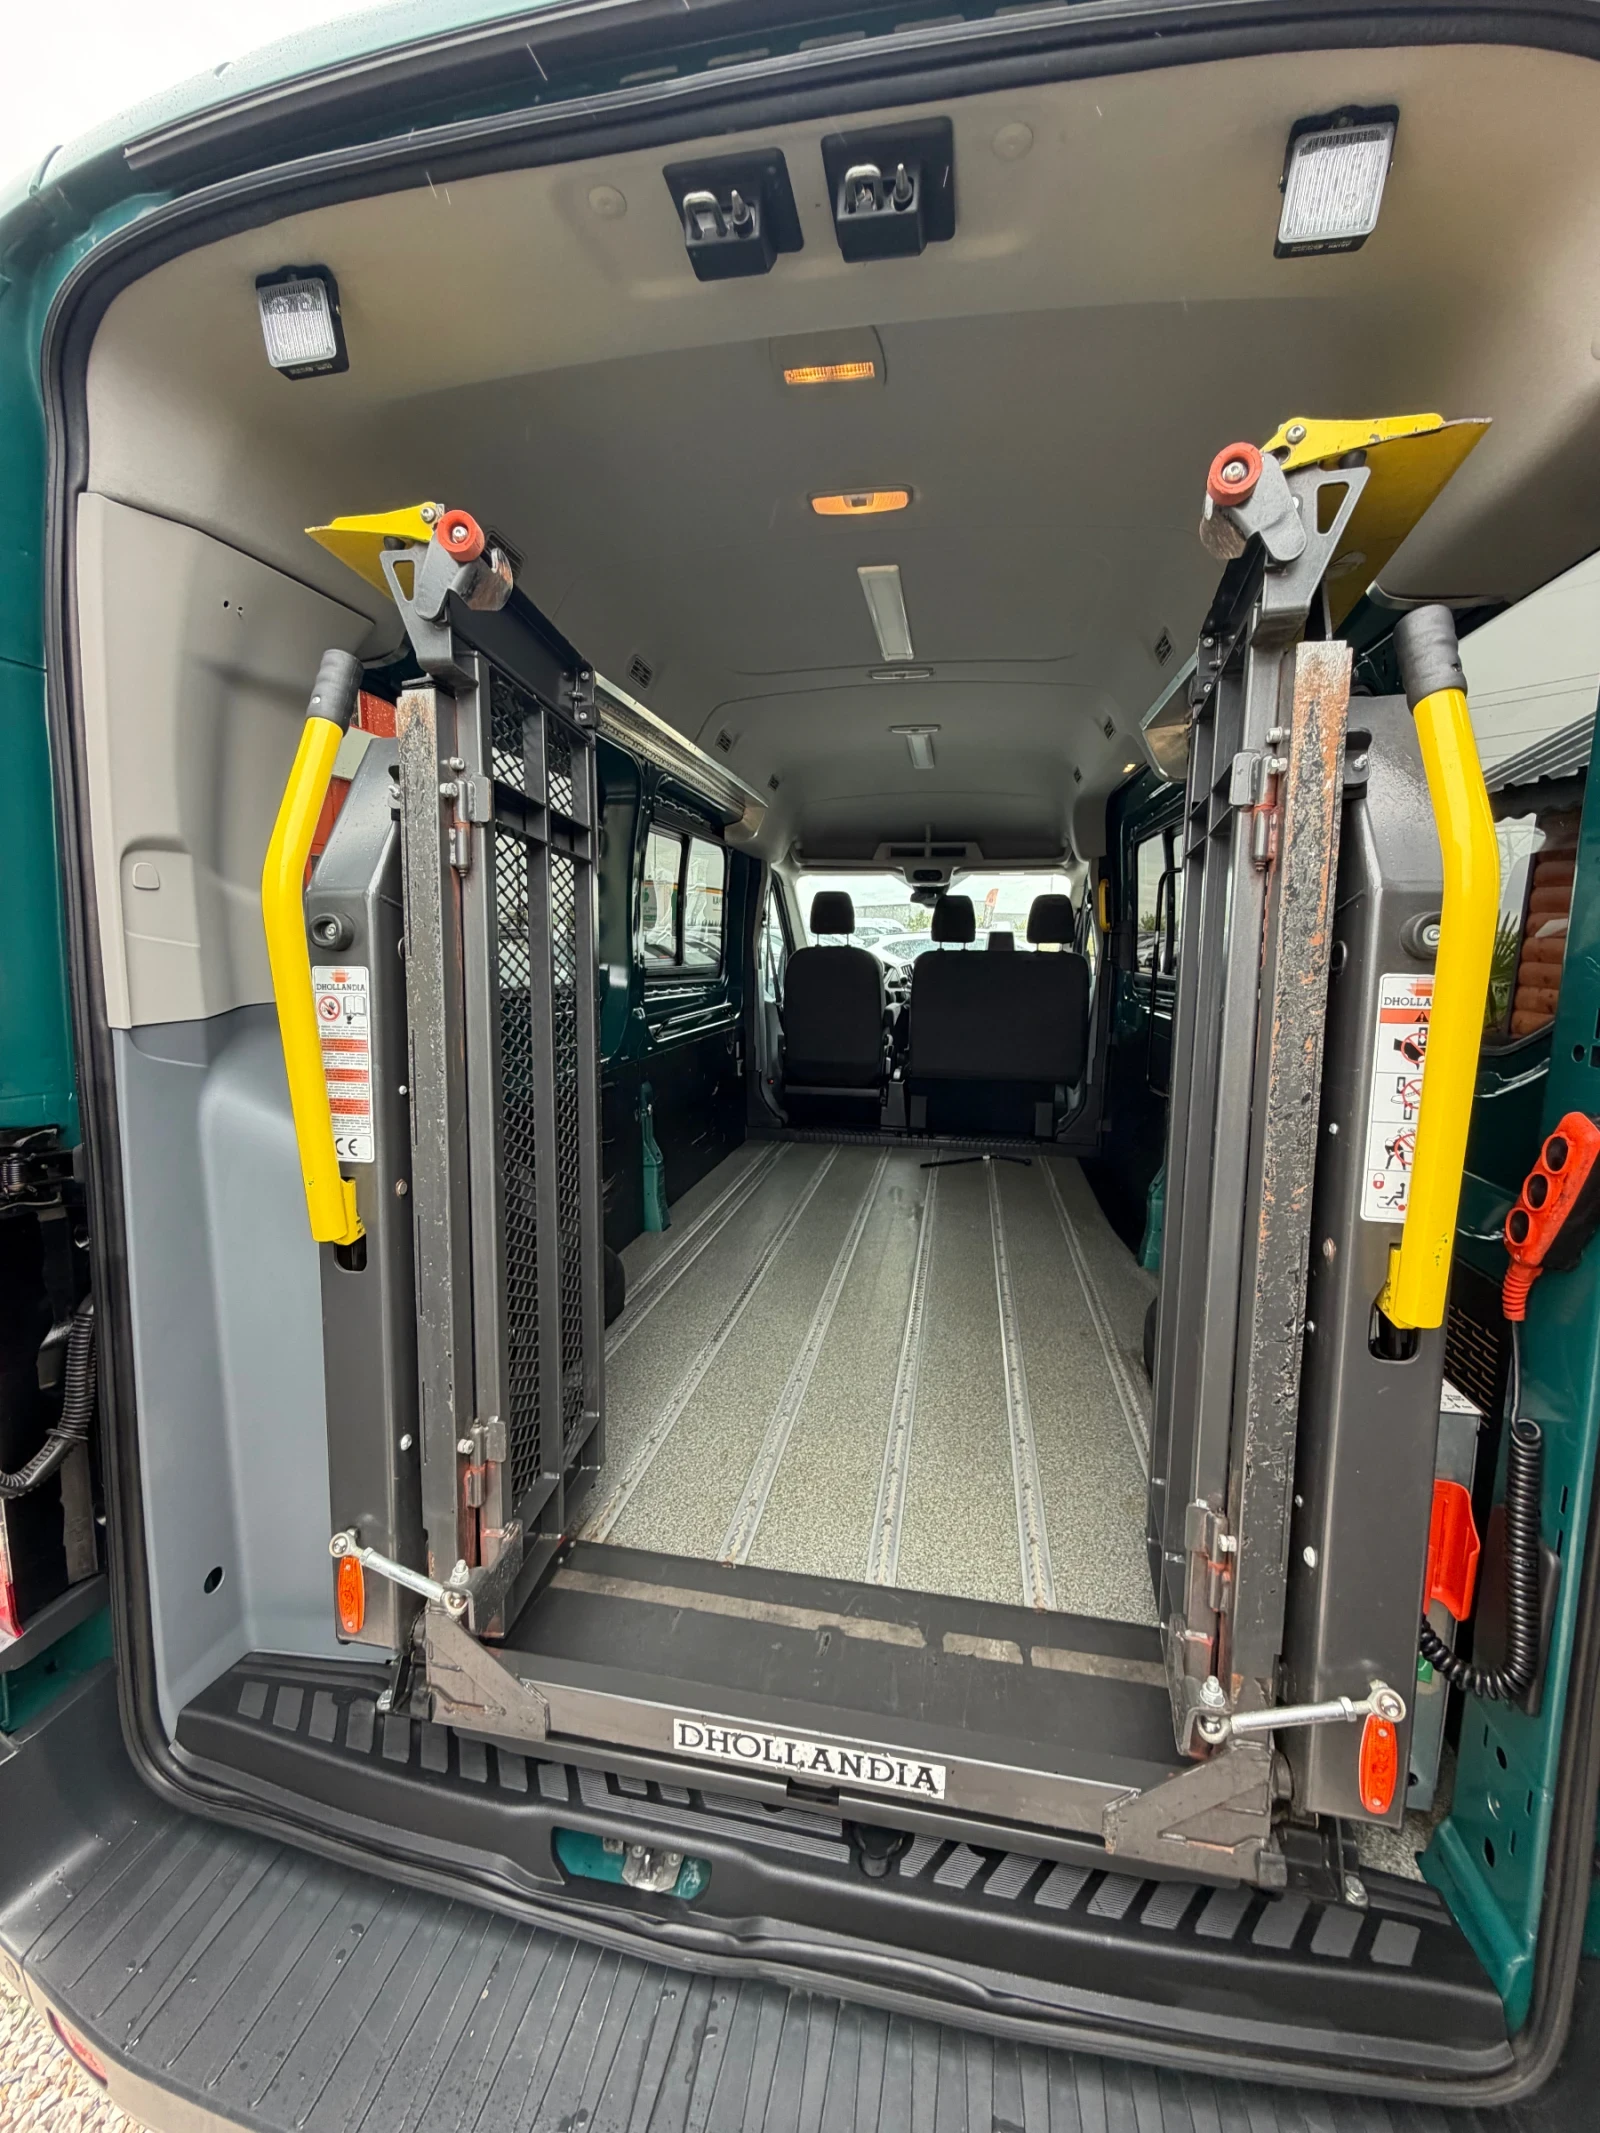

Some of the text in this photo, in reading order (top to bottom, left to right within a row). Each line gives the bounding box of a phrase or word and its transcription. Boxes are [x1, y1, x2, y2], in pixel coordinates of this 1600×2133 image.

[316, 983, 366, 991] DHOLLANDIA
[1384, 996, 1433, 1006] DHOLLA
[678, 1723, 940, 1793] DHOLLANDIA
